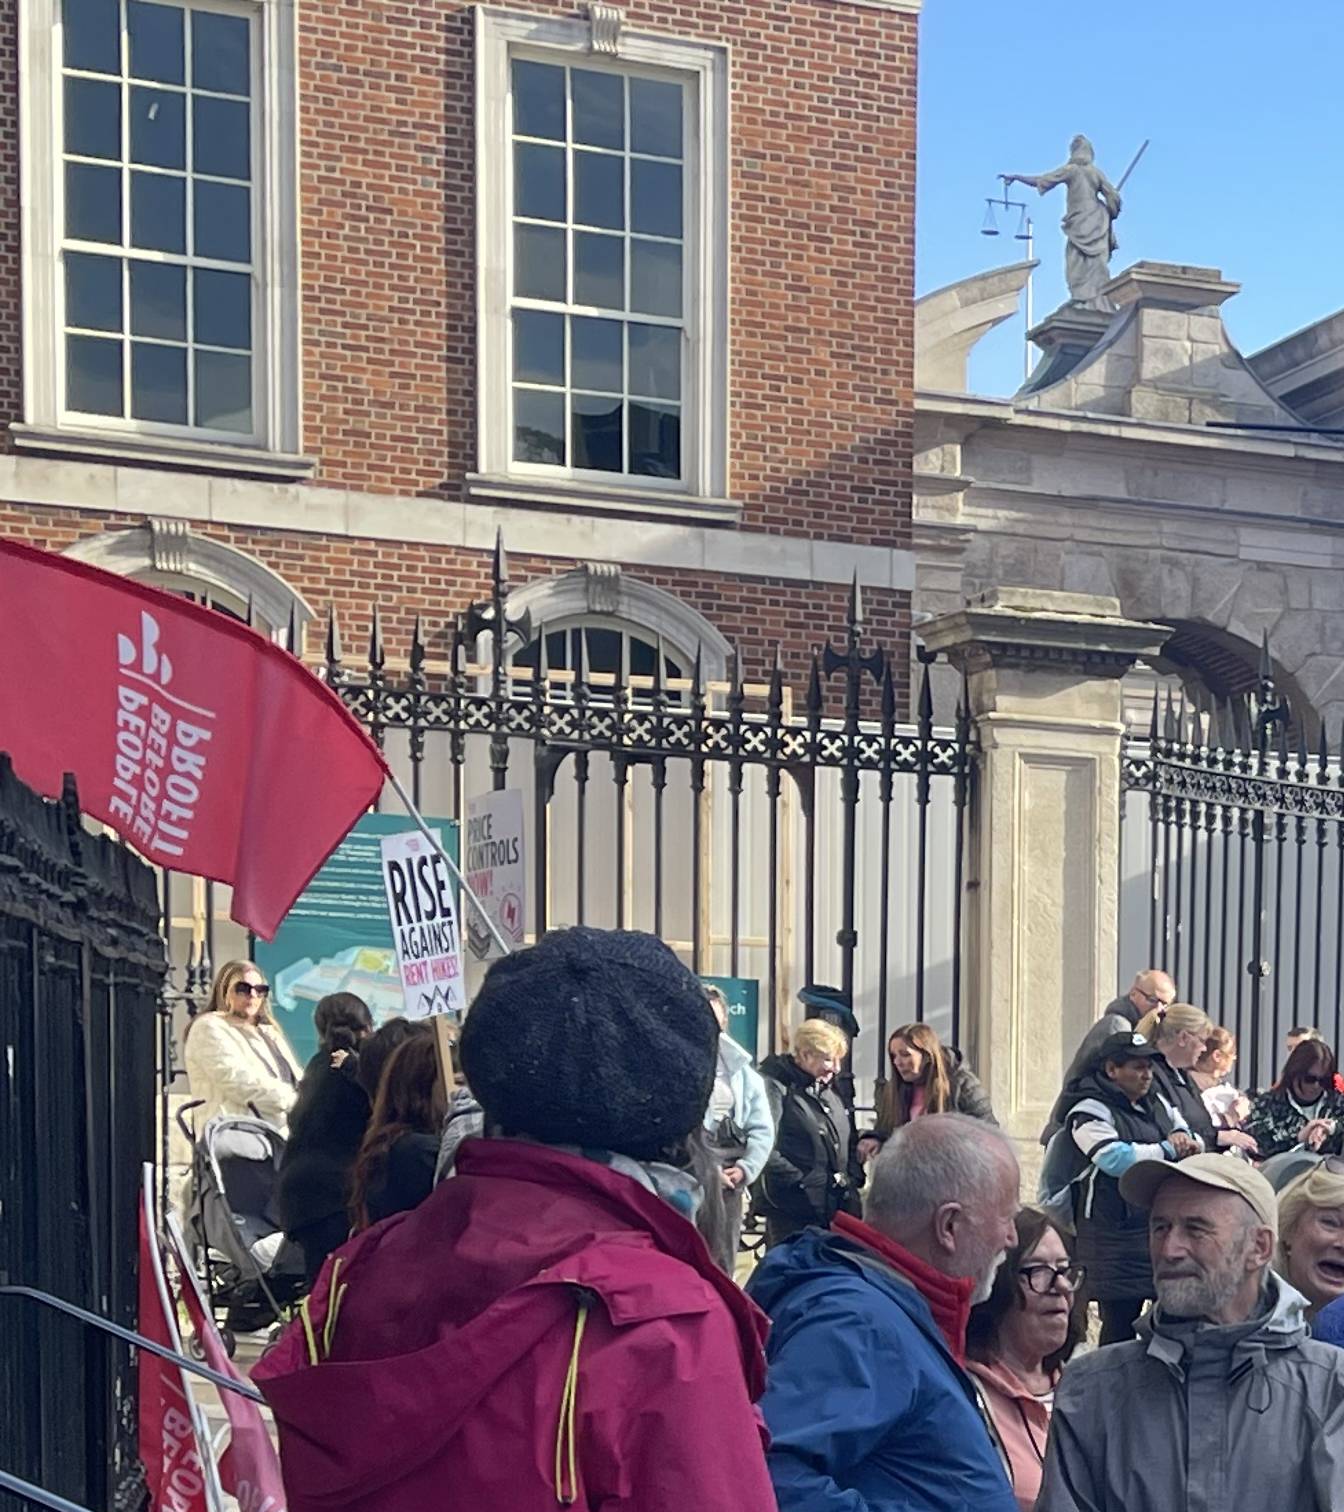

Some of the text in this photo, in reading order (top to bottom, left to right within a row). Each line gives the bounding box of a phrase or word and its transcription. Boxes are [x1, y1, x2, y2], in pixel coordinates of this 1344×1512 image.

[467, 813, 493, 841] PRICE
[467, 837, 519, 872] CONTROLS
[387, 854, 451, 927] RISE
[400, 920, 454, 960] AGAINST
[403, 959, 429, 986] RENT
[729, 1003, 746, 1015] ch
